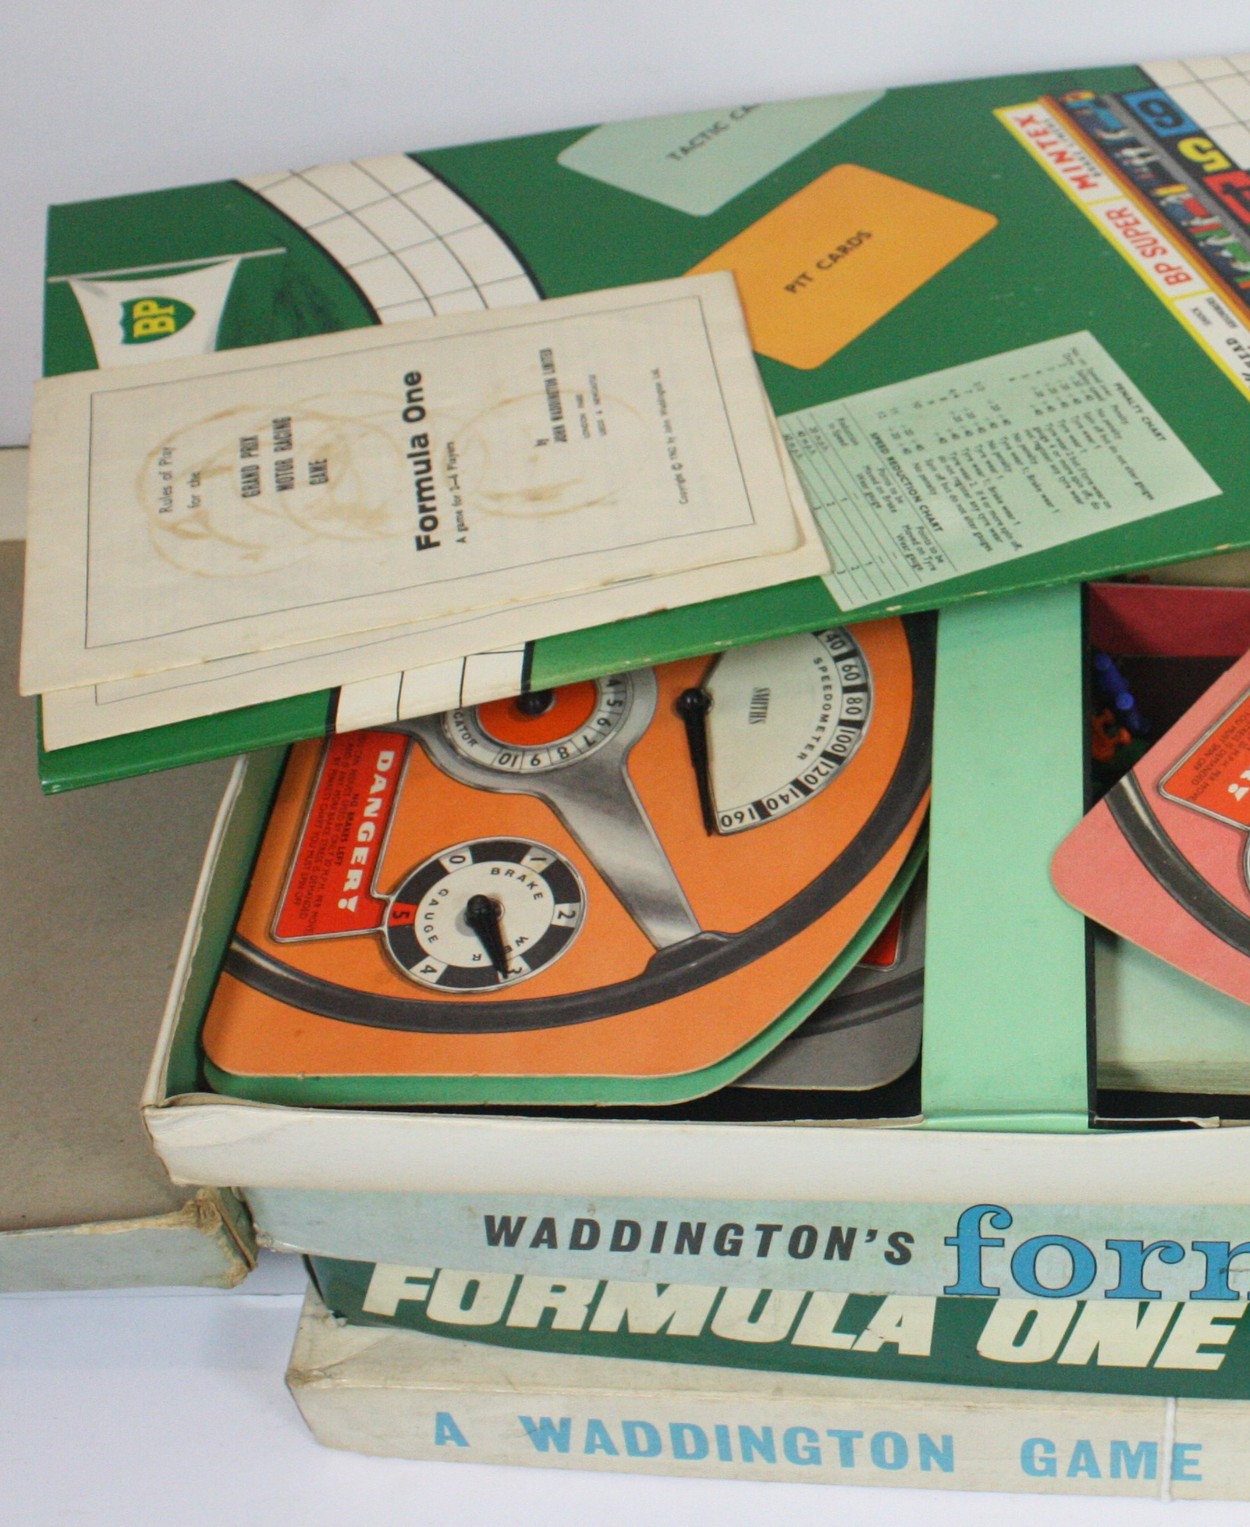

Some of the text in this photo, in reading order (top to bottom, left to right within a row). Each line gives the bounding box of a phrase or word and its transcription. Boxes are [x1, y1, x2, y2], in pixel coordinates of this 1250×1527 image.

[666, 121, 729, 162] TACTIC
[1137, 99, 1185, 132] 6
[1013, 114, 1099, 191] MINTEX
[1177, 136, 1231, 172] 5
[784, 229, 873, 294] PIT CARDS
[1103, 206, 1192, 287] BP SUPER
[131, 299, 176, 338] BP
[538, 347, 568, 444] JOHN WADDINGTON LIMITED
[1111, 381, 1168, 443] PENALTY CHART
[239, 435, 261, 498] GRAND PRIX
[272, 416, 295, 492] MOTOR RACING
[402, 370, 441, 552] Formula One
[534, 438, 550, 448] by
[158, 447, 176, 515] Rules of Play
[187, 470, 202, 510] for the
[308, 458, 330, 486] GAME
[446, 441, 469, 545] A game for Players
[867, 431, 945, 533] SPEED REDUCTION CHART
[824, 630, 847, 651] 40
[841, 663, 862, 682] 60
[748, 686, 771, 725] SMITHS
[797, 656, 834, 762] SPEEDOMETER
[845, 696, 863, 716] 80
[831, 727, 857, 754] 100
[804, 760, 834, 786] 120
[721, 807, 757, 828] 160
[766, 787, 800, 812] 140
[337, 751, 395, 912] DANGER!
[490, 866, 544, 901] BRAKE
[423, 887, 449, 944] GAUGE
[484, 1214, 915, 1266] WADDINGTON'S
[362, 1261, 1249, 1371] FORMULA ONE
[434, 1411, 1204, 1481] A WADDINGTON GAME
